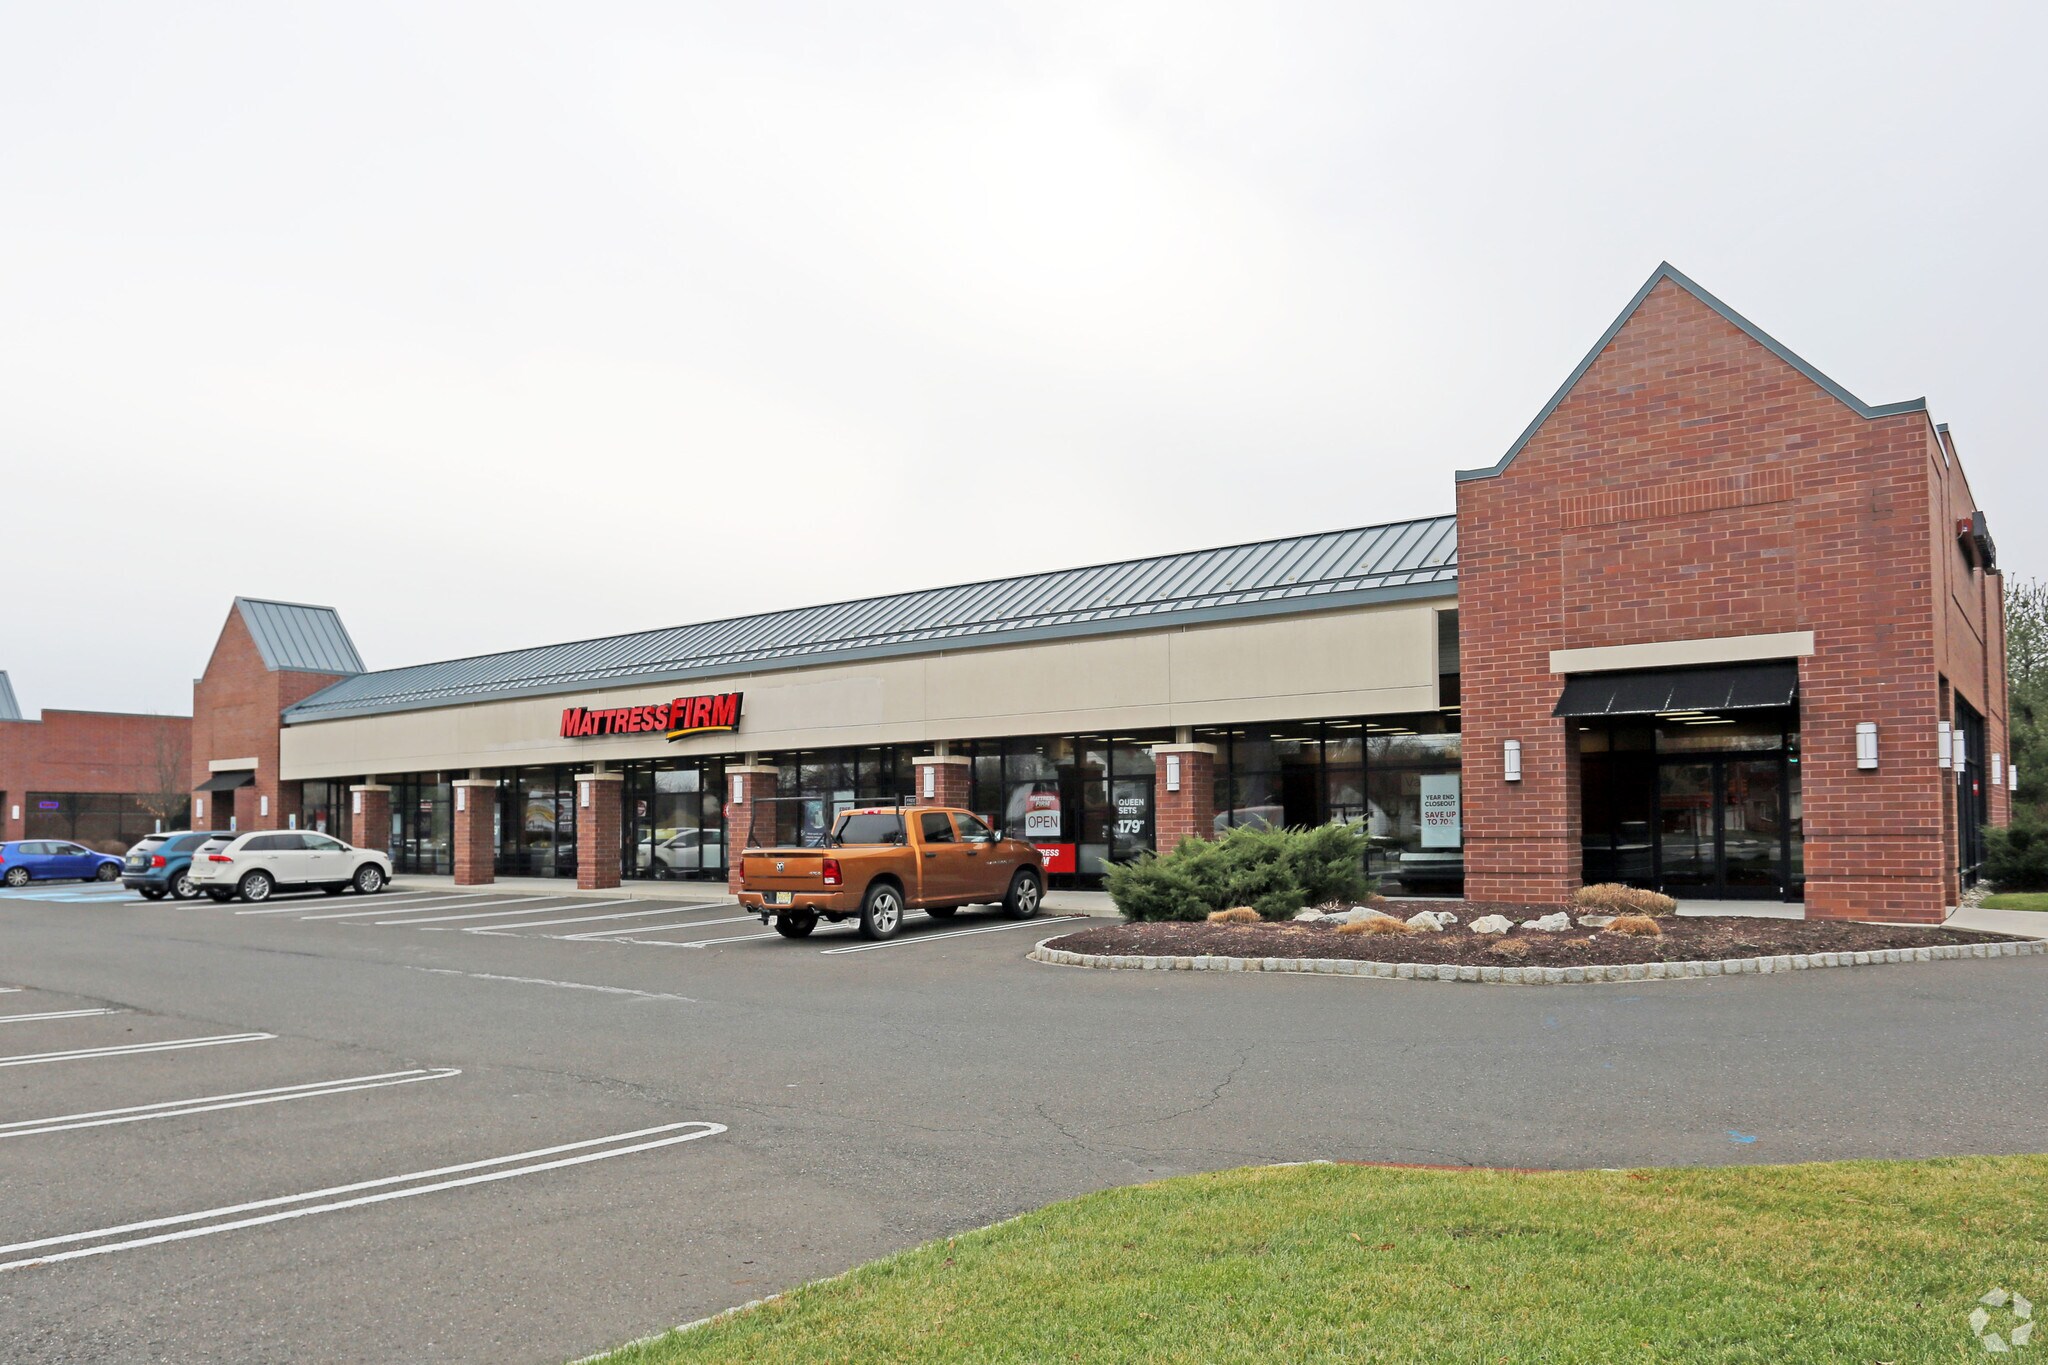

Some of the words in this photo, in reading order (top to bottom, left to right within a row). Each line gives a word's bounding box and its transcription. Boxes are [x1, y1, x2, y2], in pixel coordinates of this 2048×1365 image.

[560, 705, 670, 737] MATTRESS
[668, 693, 738, 729] FIRM
[1118, 798, 1145, 806] QUEEN
[1118, 806, 1138, 814] SETS
[1028, 815, 1059, 828] OPEN
